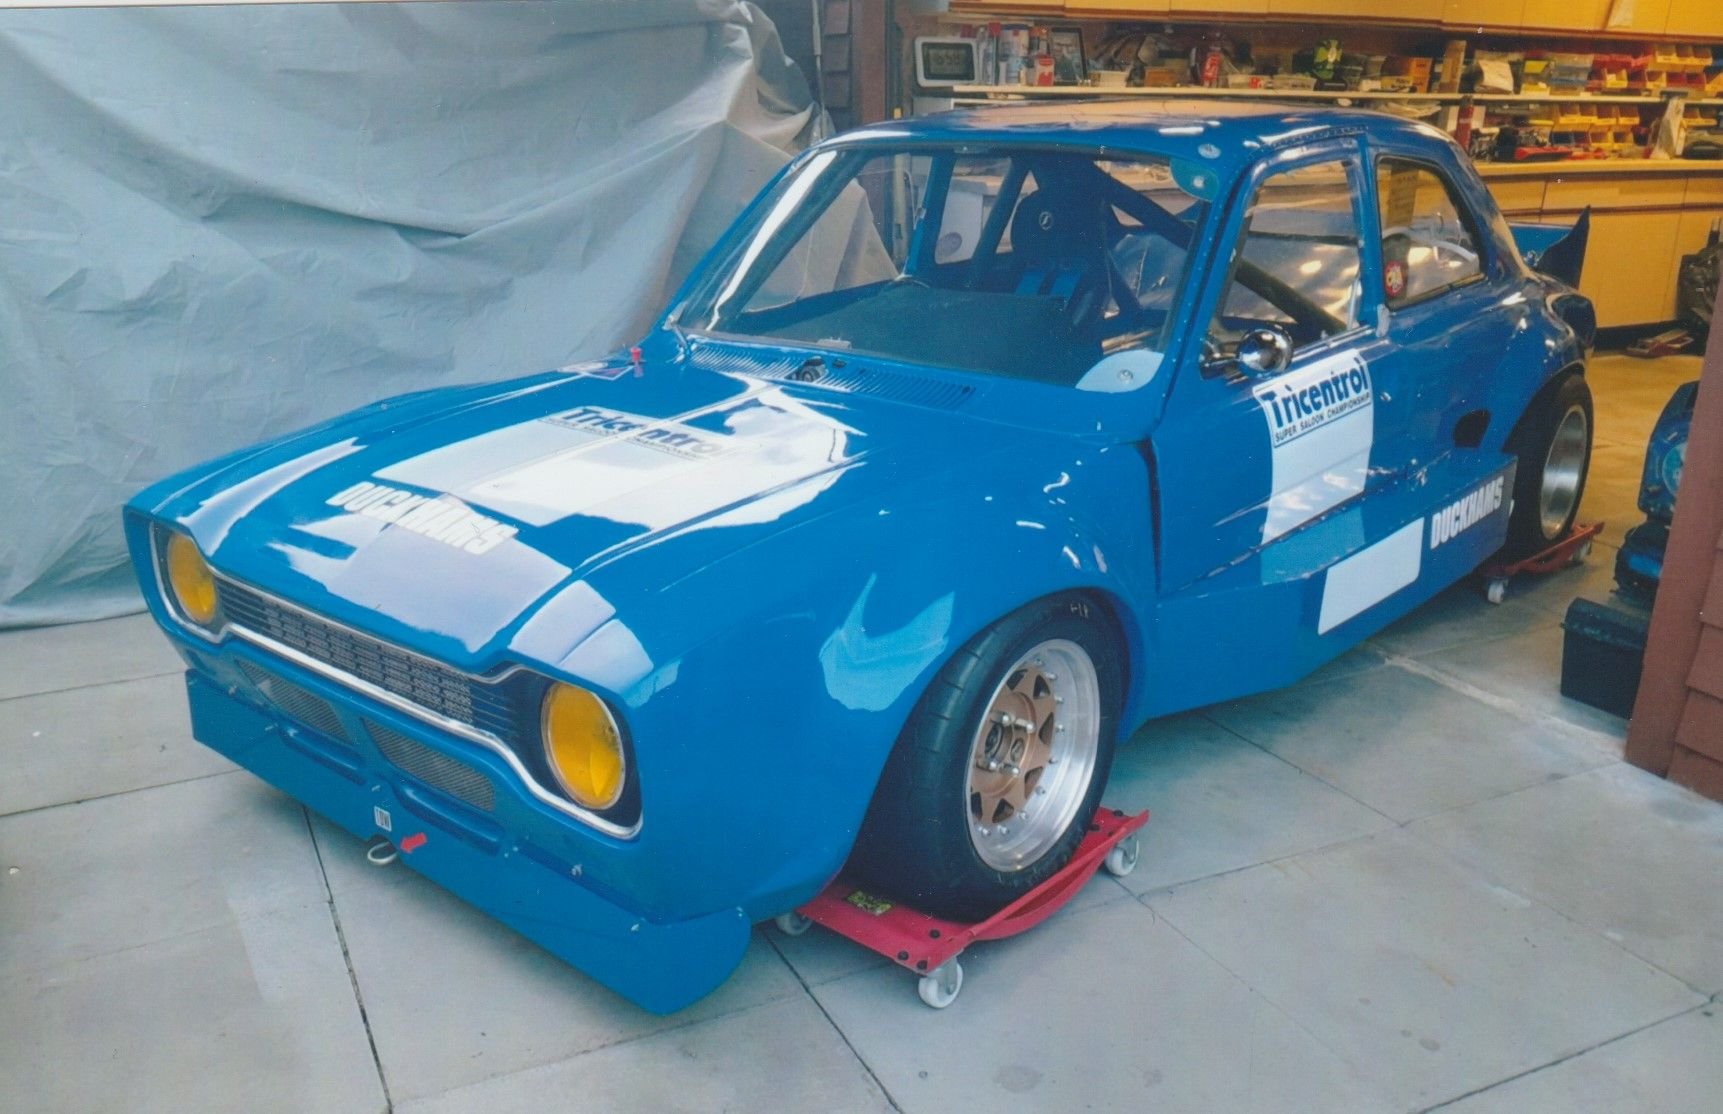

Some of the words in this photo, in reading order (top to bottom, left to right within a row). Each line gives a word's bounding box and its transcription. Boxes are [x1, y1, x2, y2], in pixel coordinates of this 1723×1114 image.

[1260, 357, 1369, 428] Tricentrol
[1275, 424, 1297, 442] SUPER
[1300, 413, 1325, 431] SALOON
[1327, 392, 1370, 419] CHAMPIONSHIP
[325, 480, 519, 555] DUCKHAMS
[1430, 475, 1504, 550] DUCKHAMS
